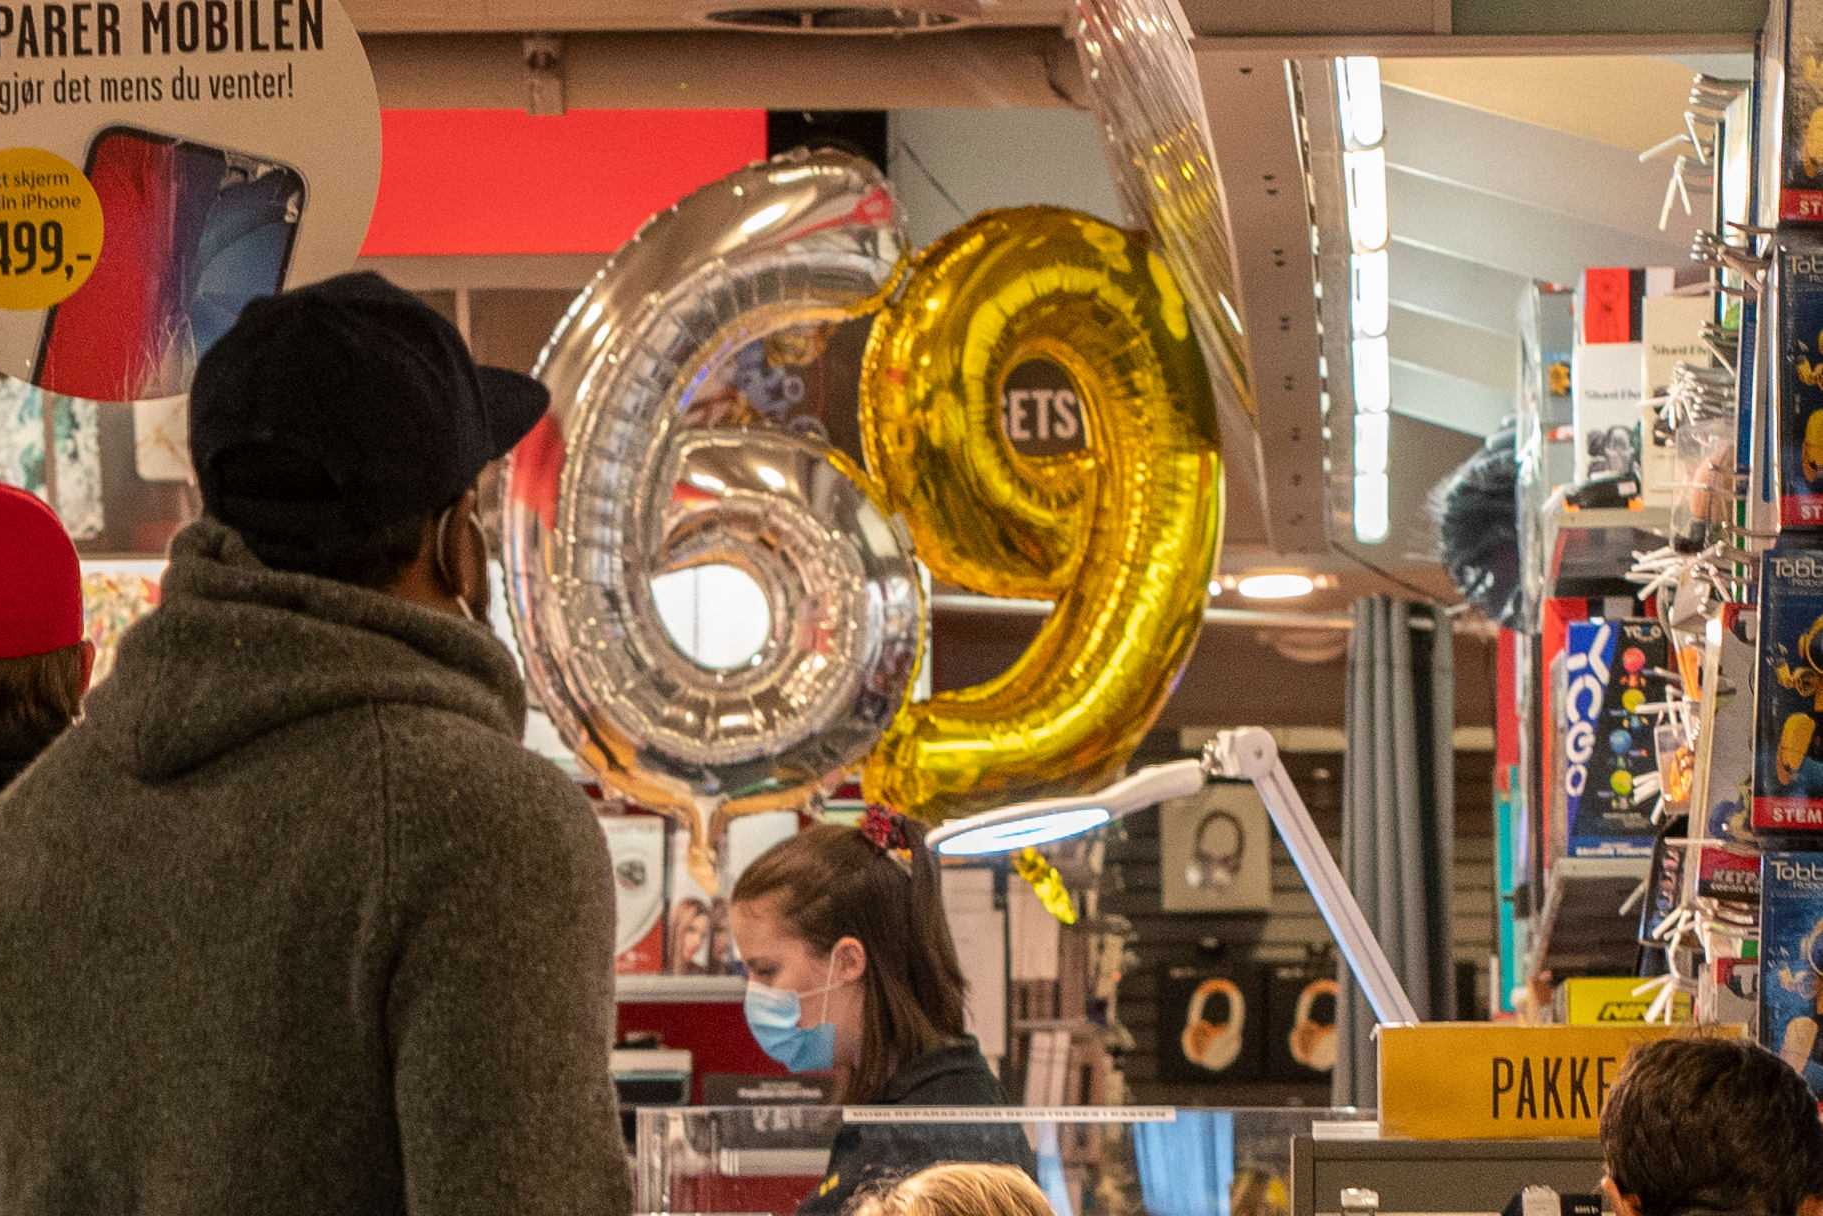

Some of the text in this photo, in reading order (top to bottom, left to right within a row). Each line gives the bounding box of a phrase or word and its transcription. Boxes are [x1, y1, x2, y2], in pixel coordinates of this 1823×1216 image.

[142, 0, 324, 54] MOBILEN
[53, 68, 91, 104] det
[100, 75, 163, 104] mens
[172, 65, 200, 101] du
[208, 62, 293, 100] venter!
[14, 170, 70, 189] skjerm
[22, 191, 81, 210] iPhone
[1000, 389, 1078, 440] ETS
